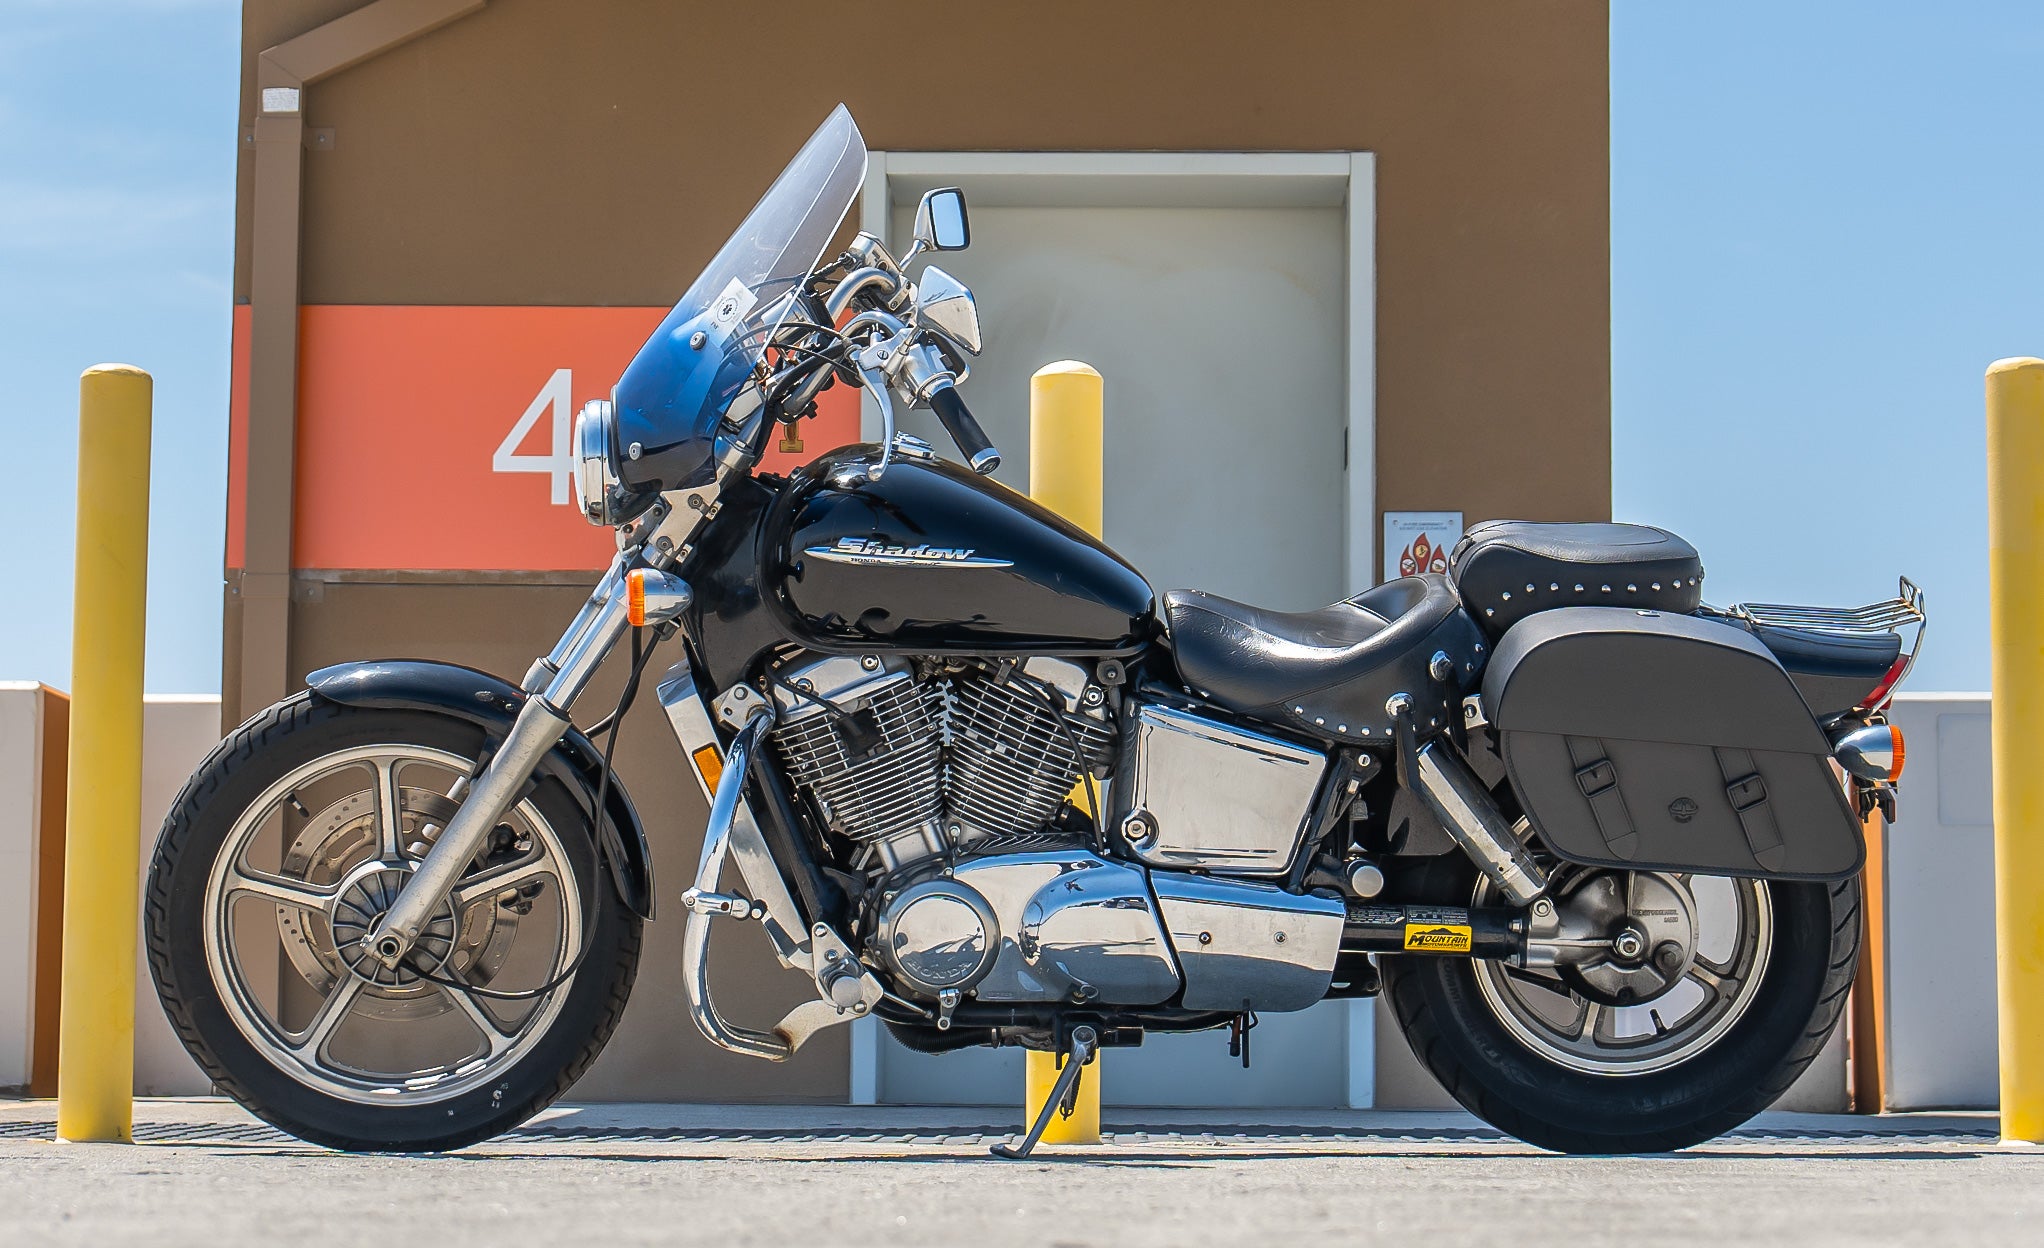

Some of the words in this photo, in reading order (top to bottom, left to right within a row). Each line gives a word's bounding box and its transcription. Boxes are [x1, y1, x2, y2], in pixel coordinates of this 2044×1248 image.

[493, 368, 575, 505] 4
[838, 537, 976, 560] Shadow
[850, 557, 881, 565] HONDA
[1406, 934, 1469, 946] MOUNTAIN
[907, 961, 973, 979] HONDA
